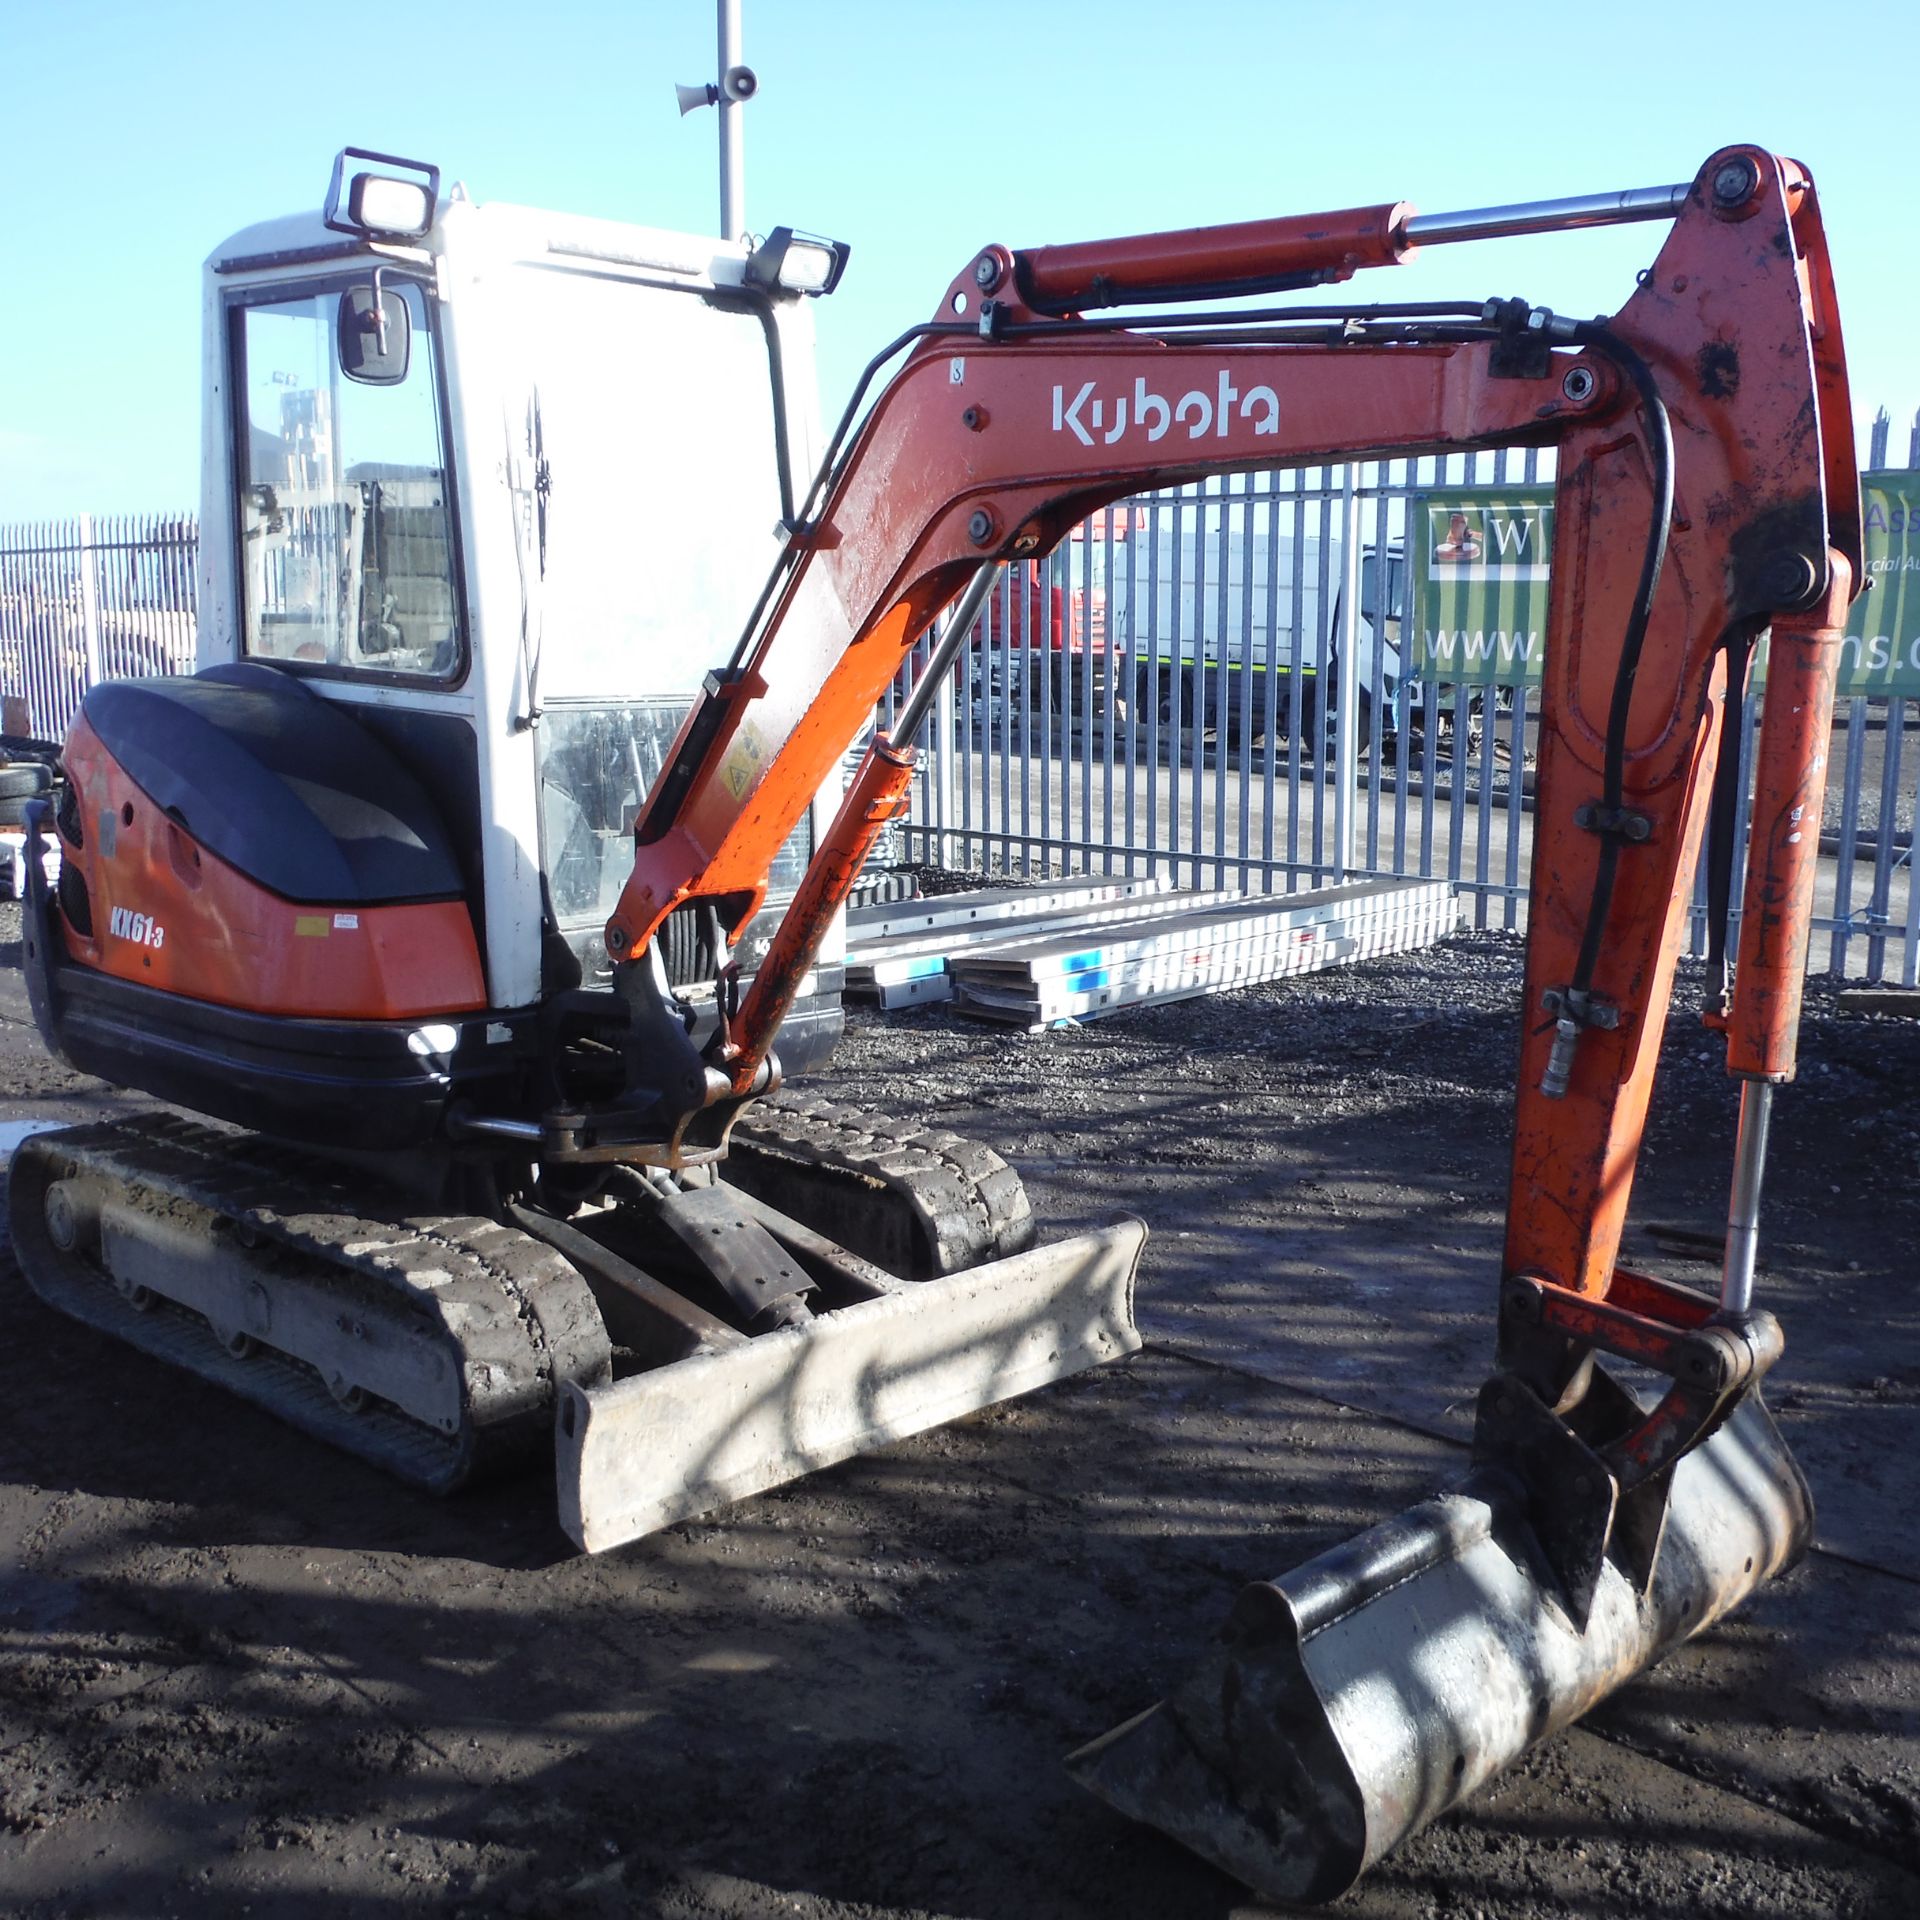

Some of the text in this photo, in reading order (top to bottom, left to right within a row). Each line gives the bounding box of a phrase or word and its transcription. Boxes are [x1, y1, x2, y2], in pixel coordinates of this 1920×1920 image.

[1052, 370, 1279, 446] Kubota
[1489, 518, 1535, 555] W
[1425, 629, 1543, 662] www.
